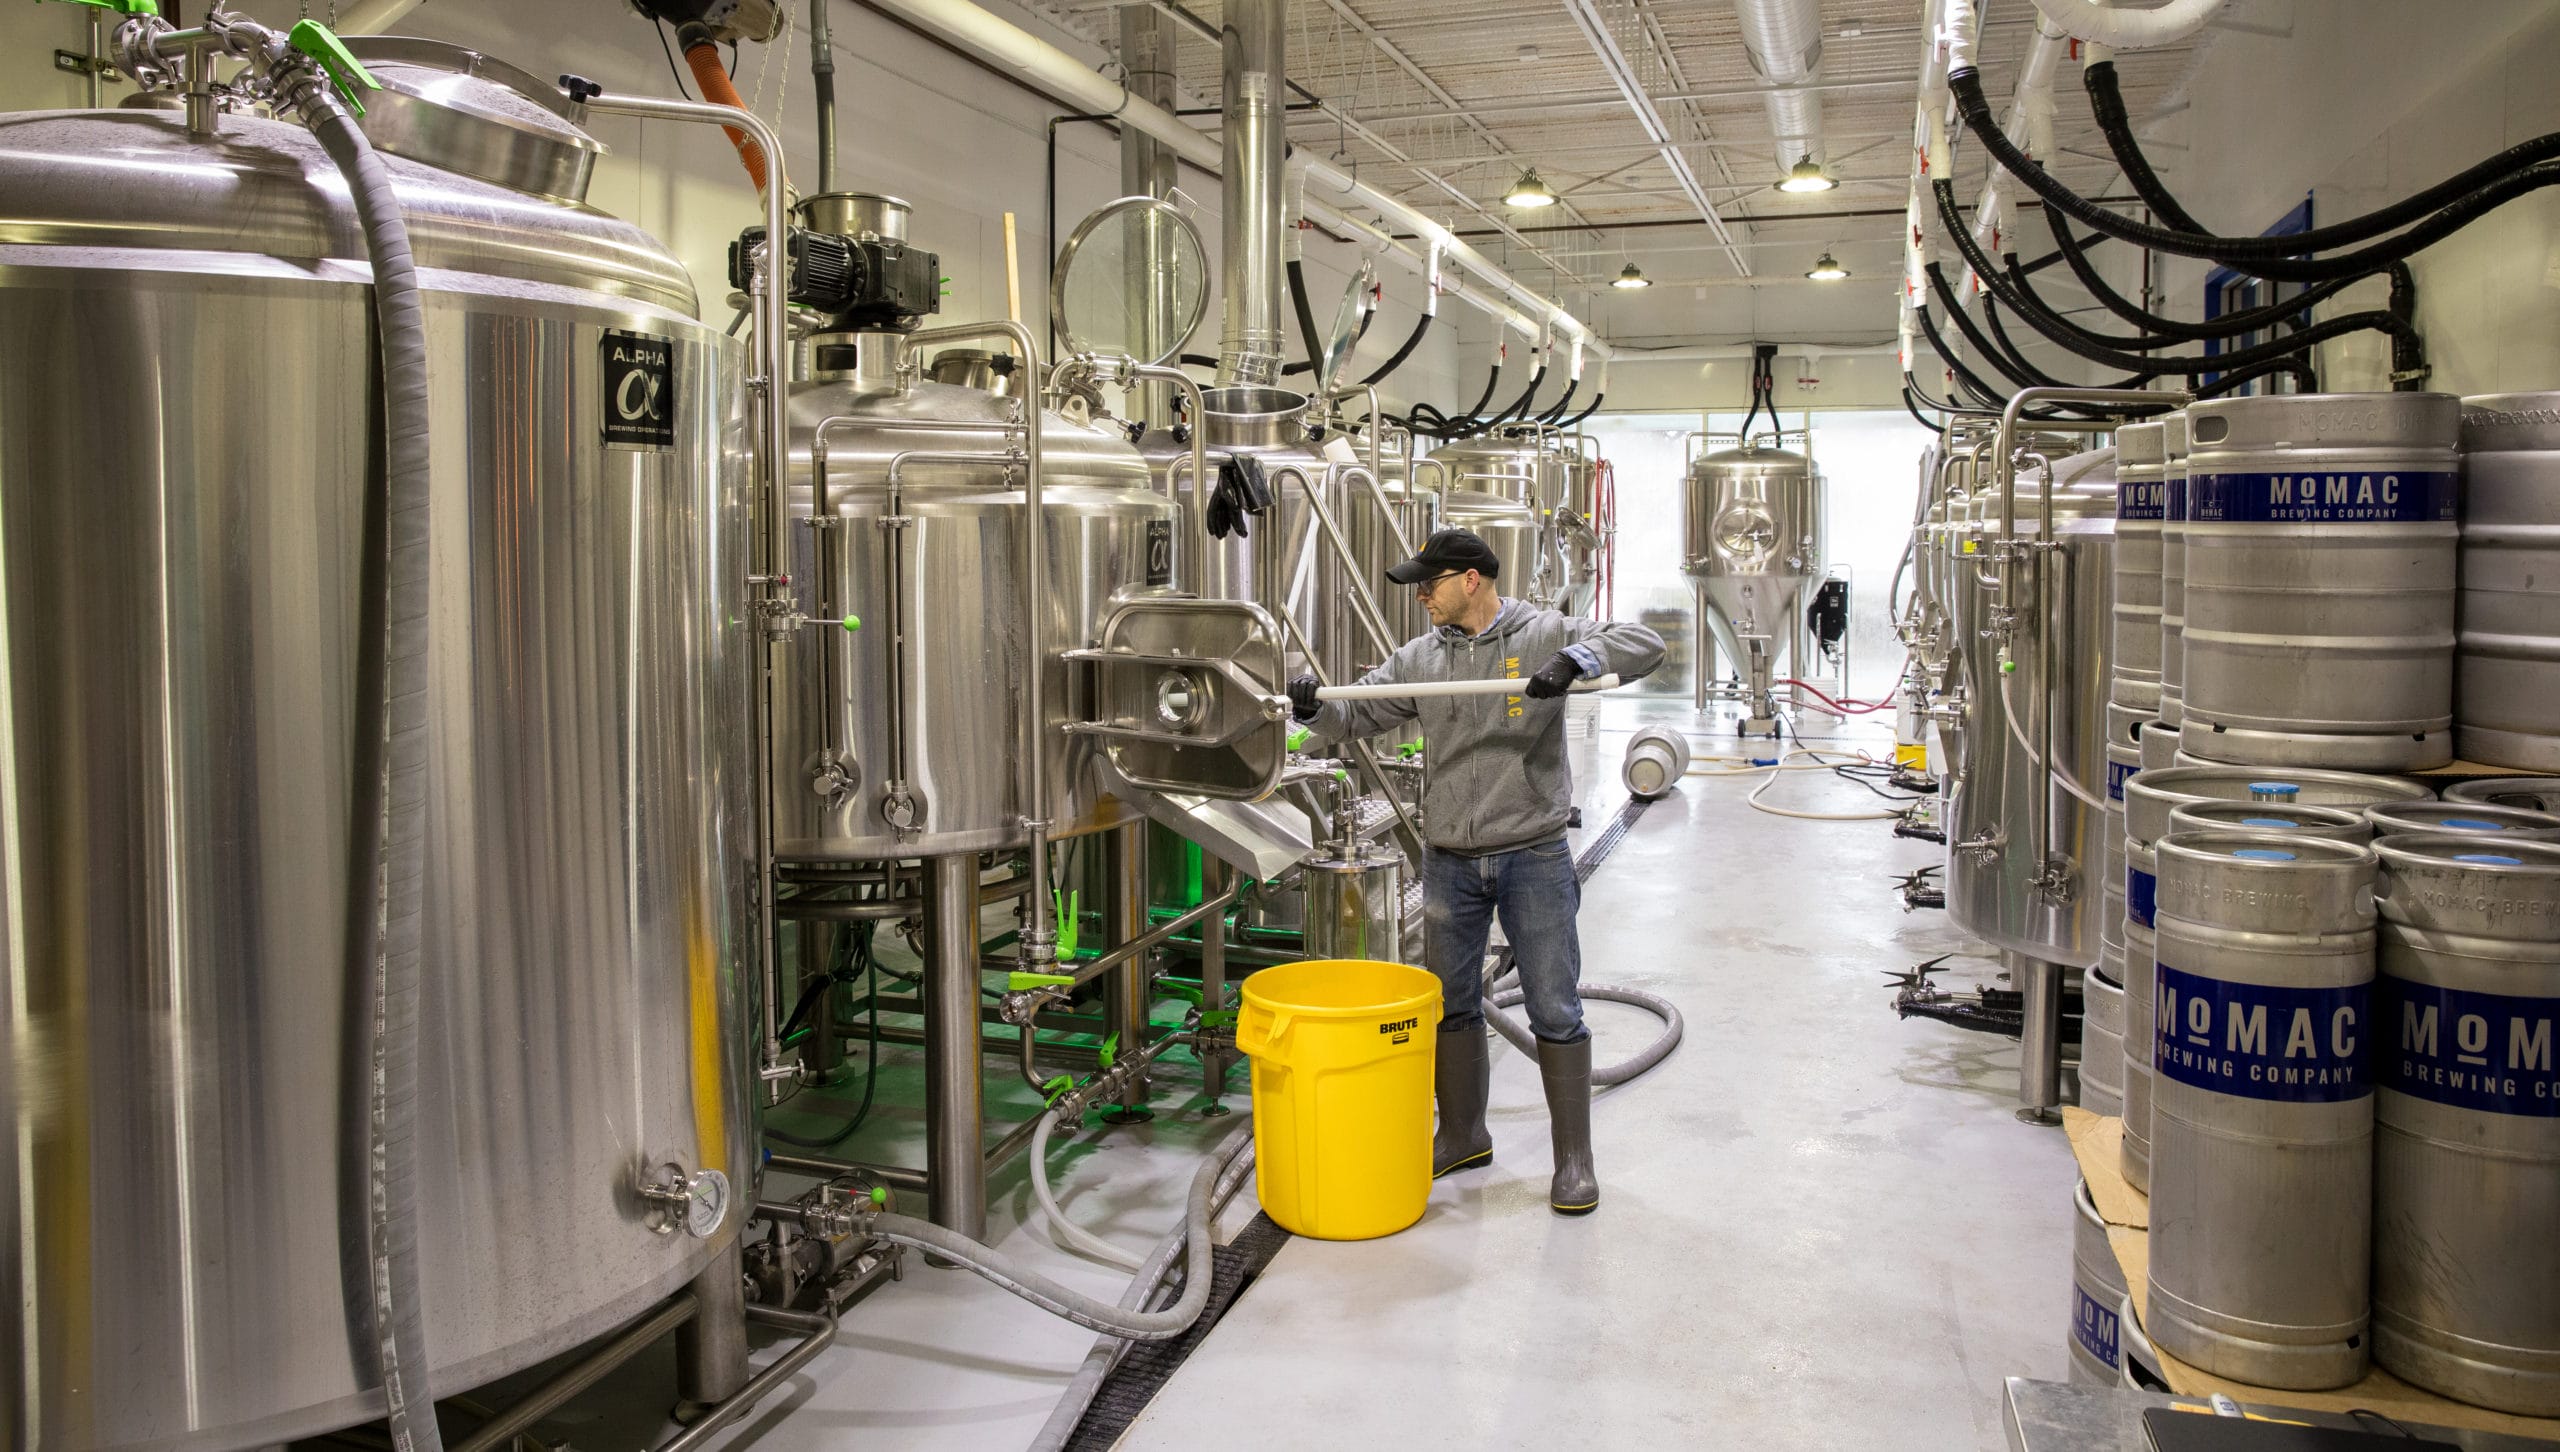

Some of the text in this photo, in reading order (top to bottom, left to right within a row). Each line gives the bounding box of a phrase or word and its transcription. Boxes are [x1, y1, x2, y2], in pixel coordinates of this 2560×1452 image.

[613, 347, 666, 367] ALPHA
[609, 424, 637, 433] BREWING
[2271, 508, 2398, 520] BREWING COMPANY
[1149, 527, 1170, 537] ALPHA
[1379, 1017, 1418, 1034] BRUTE
[2157, 1039, 2354, 1086] BREWING COMPANY
[2403, 1060, 2516, 1096] BREWING
